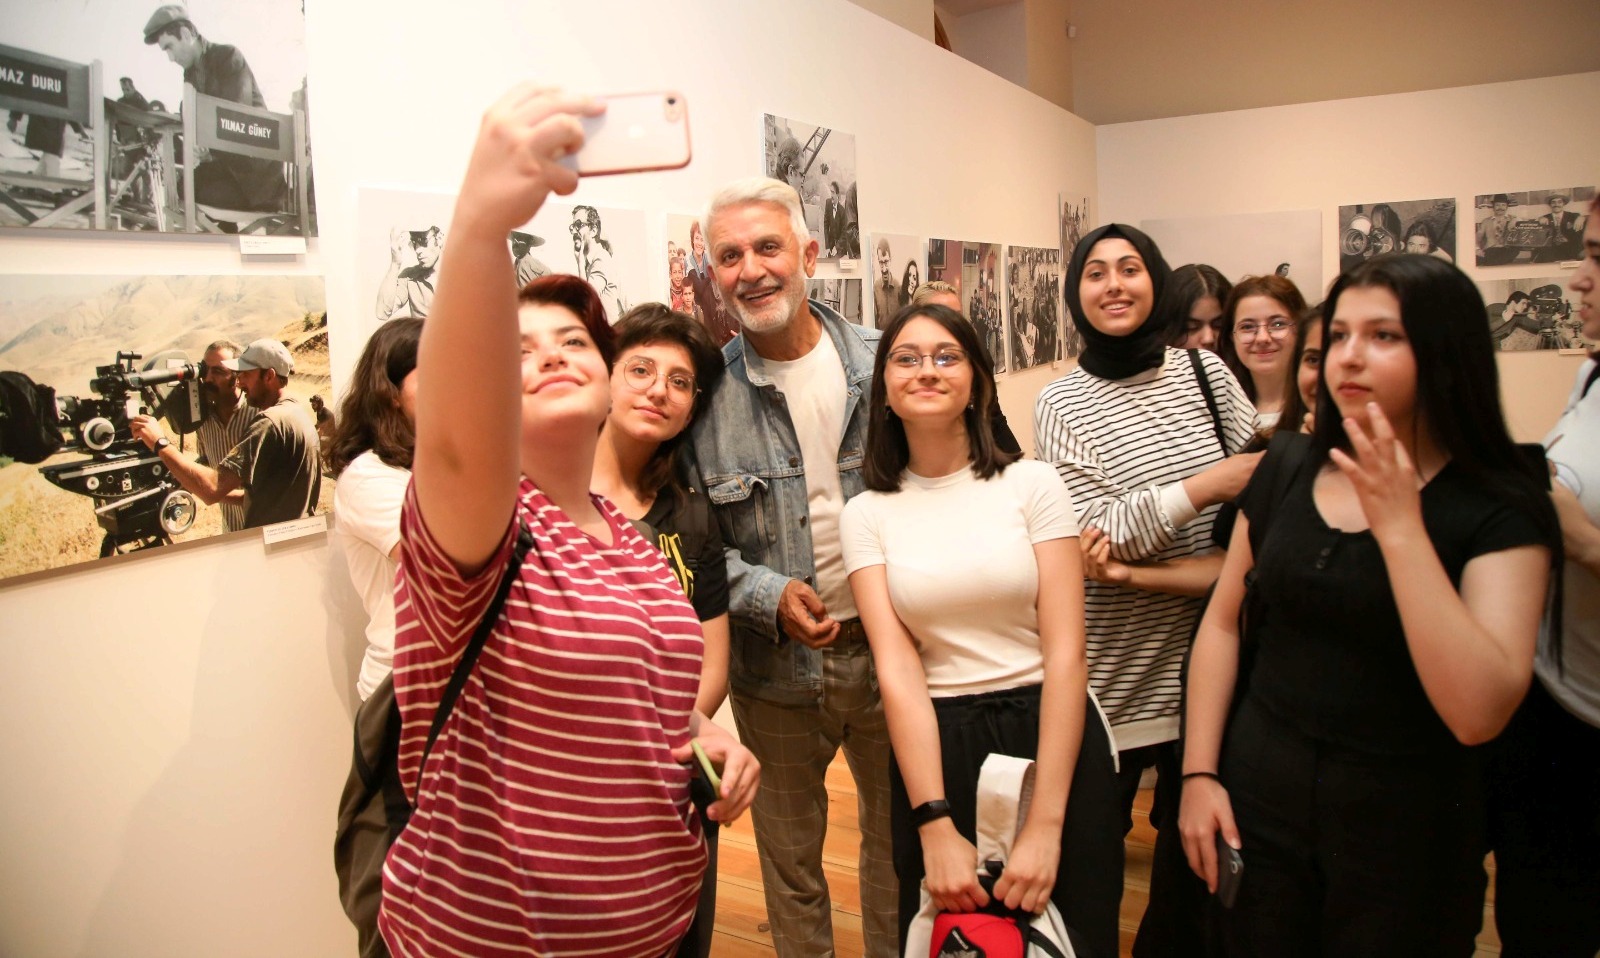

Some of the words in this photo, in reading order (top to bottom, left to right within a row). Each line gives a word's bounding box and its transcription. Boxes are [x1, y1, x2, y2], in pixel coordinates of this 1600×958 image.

[32, 73, 62, 93] DURU
[220, 117, 246, 134] YILMAZ
[248, 123, 272, 139] GÜNEY
